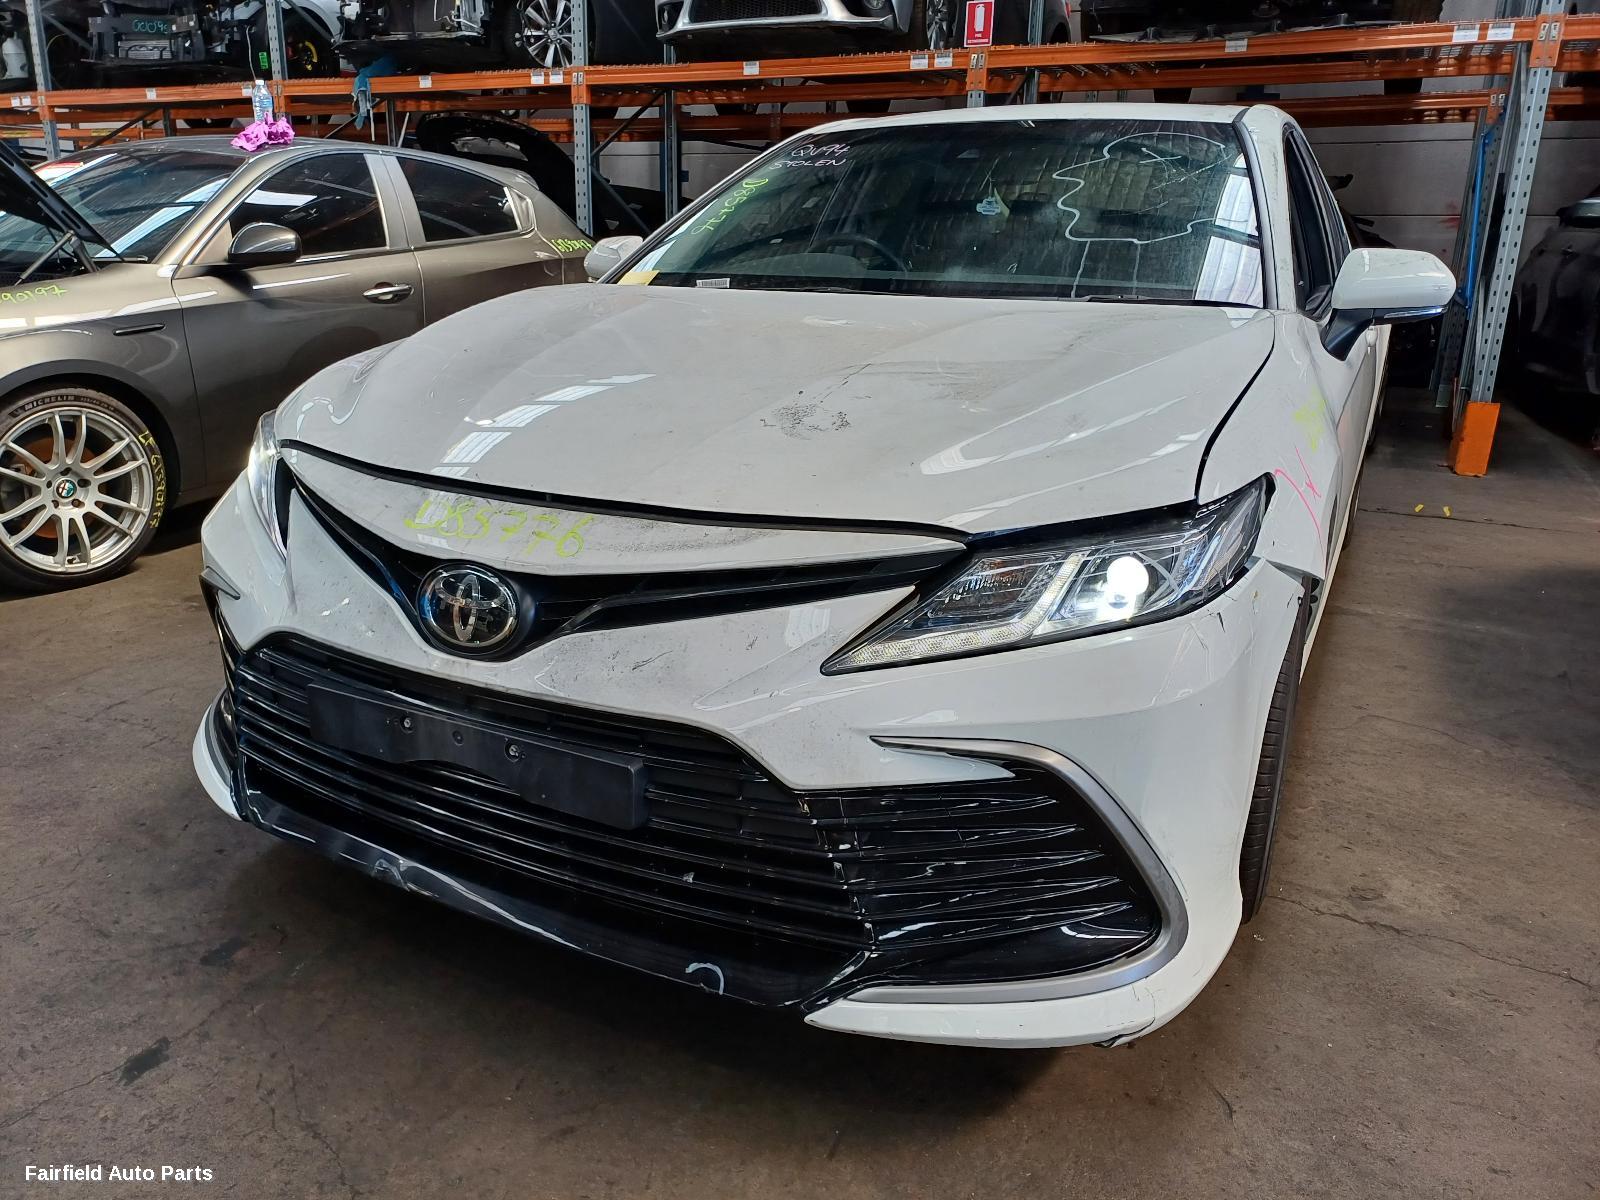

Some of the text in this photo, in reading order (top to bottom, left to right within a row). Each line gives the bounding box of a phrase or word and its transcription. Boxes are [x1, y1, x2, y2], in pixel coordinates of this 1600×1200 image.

[769, 159, 847, 169] STOLEN
[0, 284, 68, 303] 90197
[24, 395, 75, 411] MICHELIN
[138, 430, 156, 446] LF
